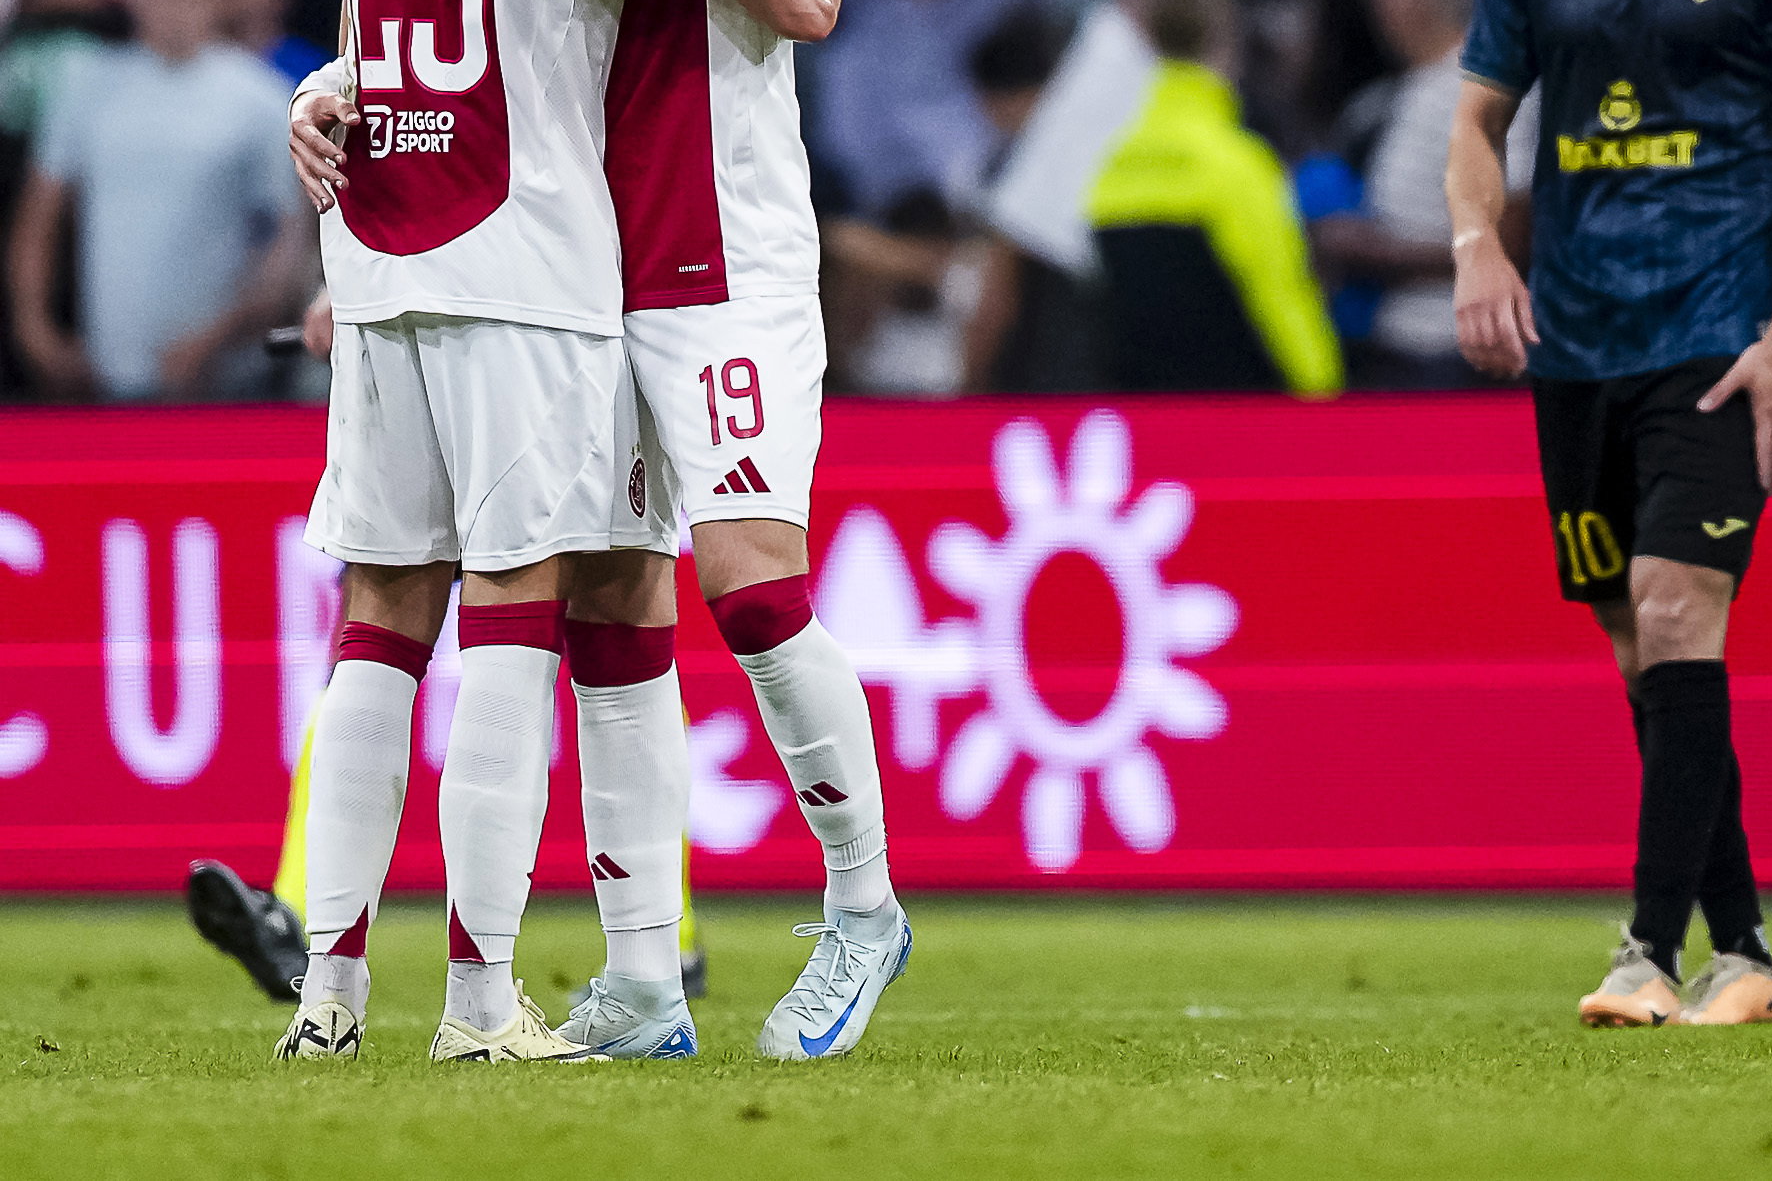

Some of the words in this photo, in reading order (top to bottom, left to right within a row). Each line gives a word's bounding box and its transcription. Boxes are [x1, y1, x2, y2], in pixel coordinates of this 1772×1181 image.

[395, 132, 454, 153] SPORT
[396, 110, 455, 132] ZIGGO
[698, 357, 765, 446] 19
[1558, 509, 1624, 584] 10
